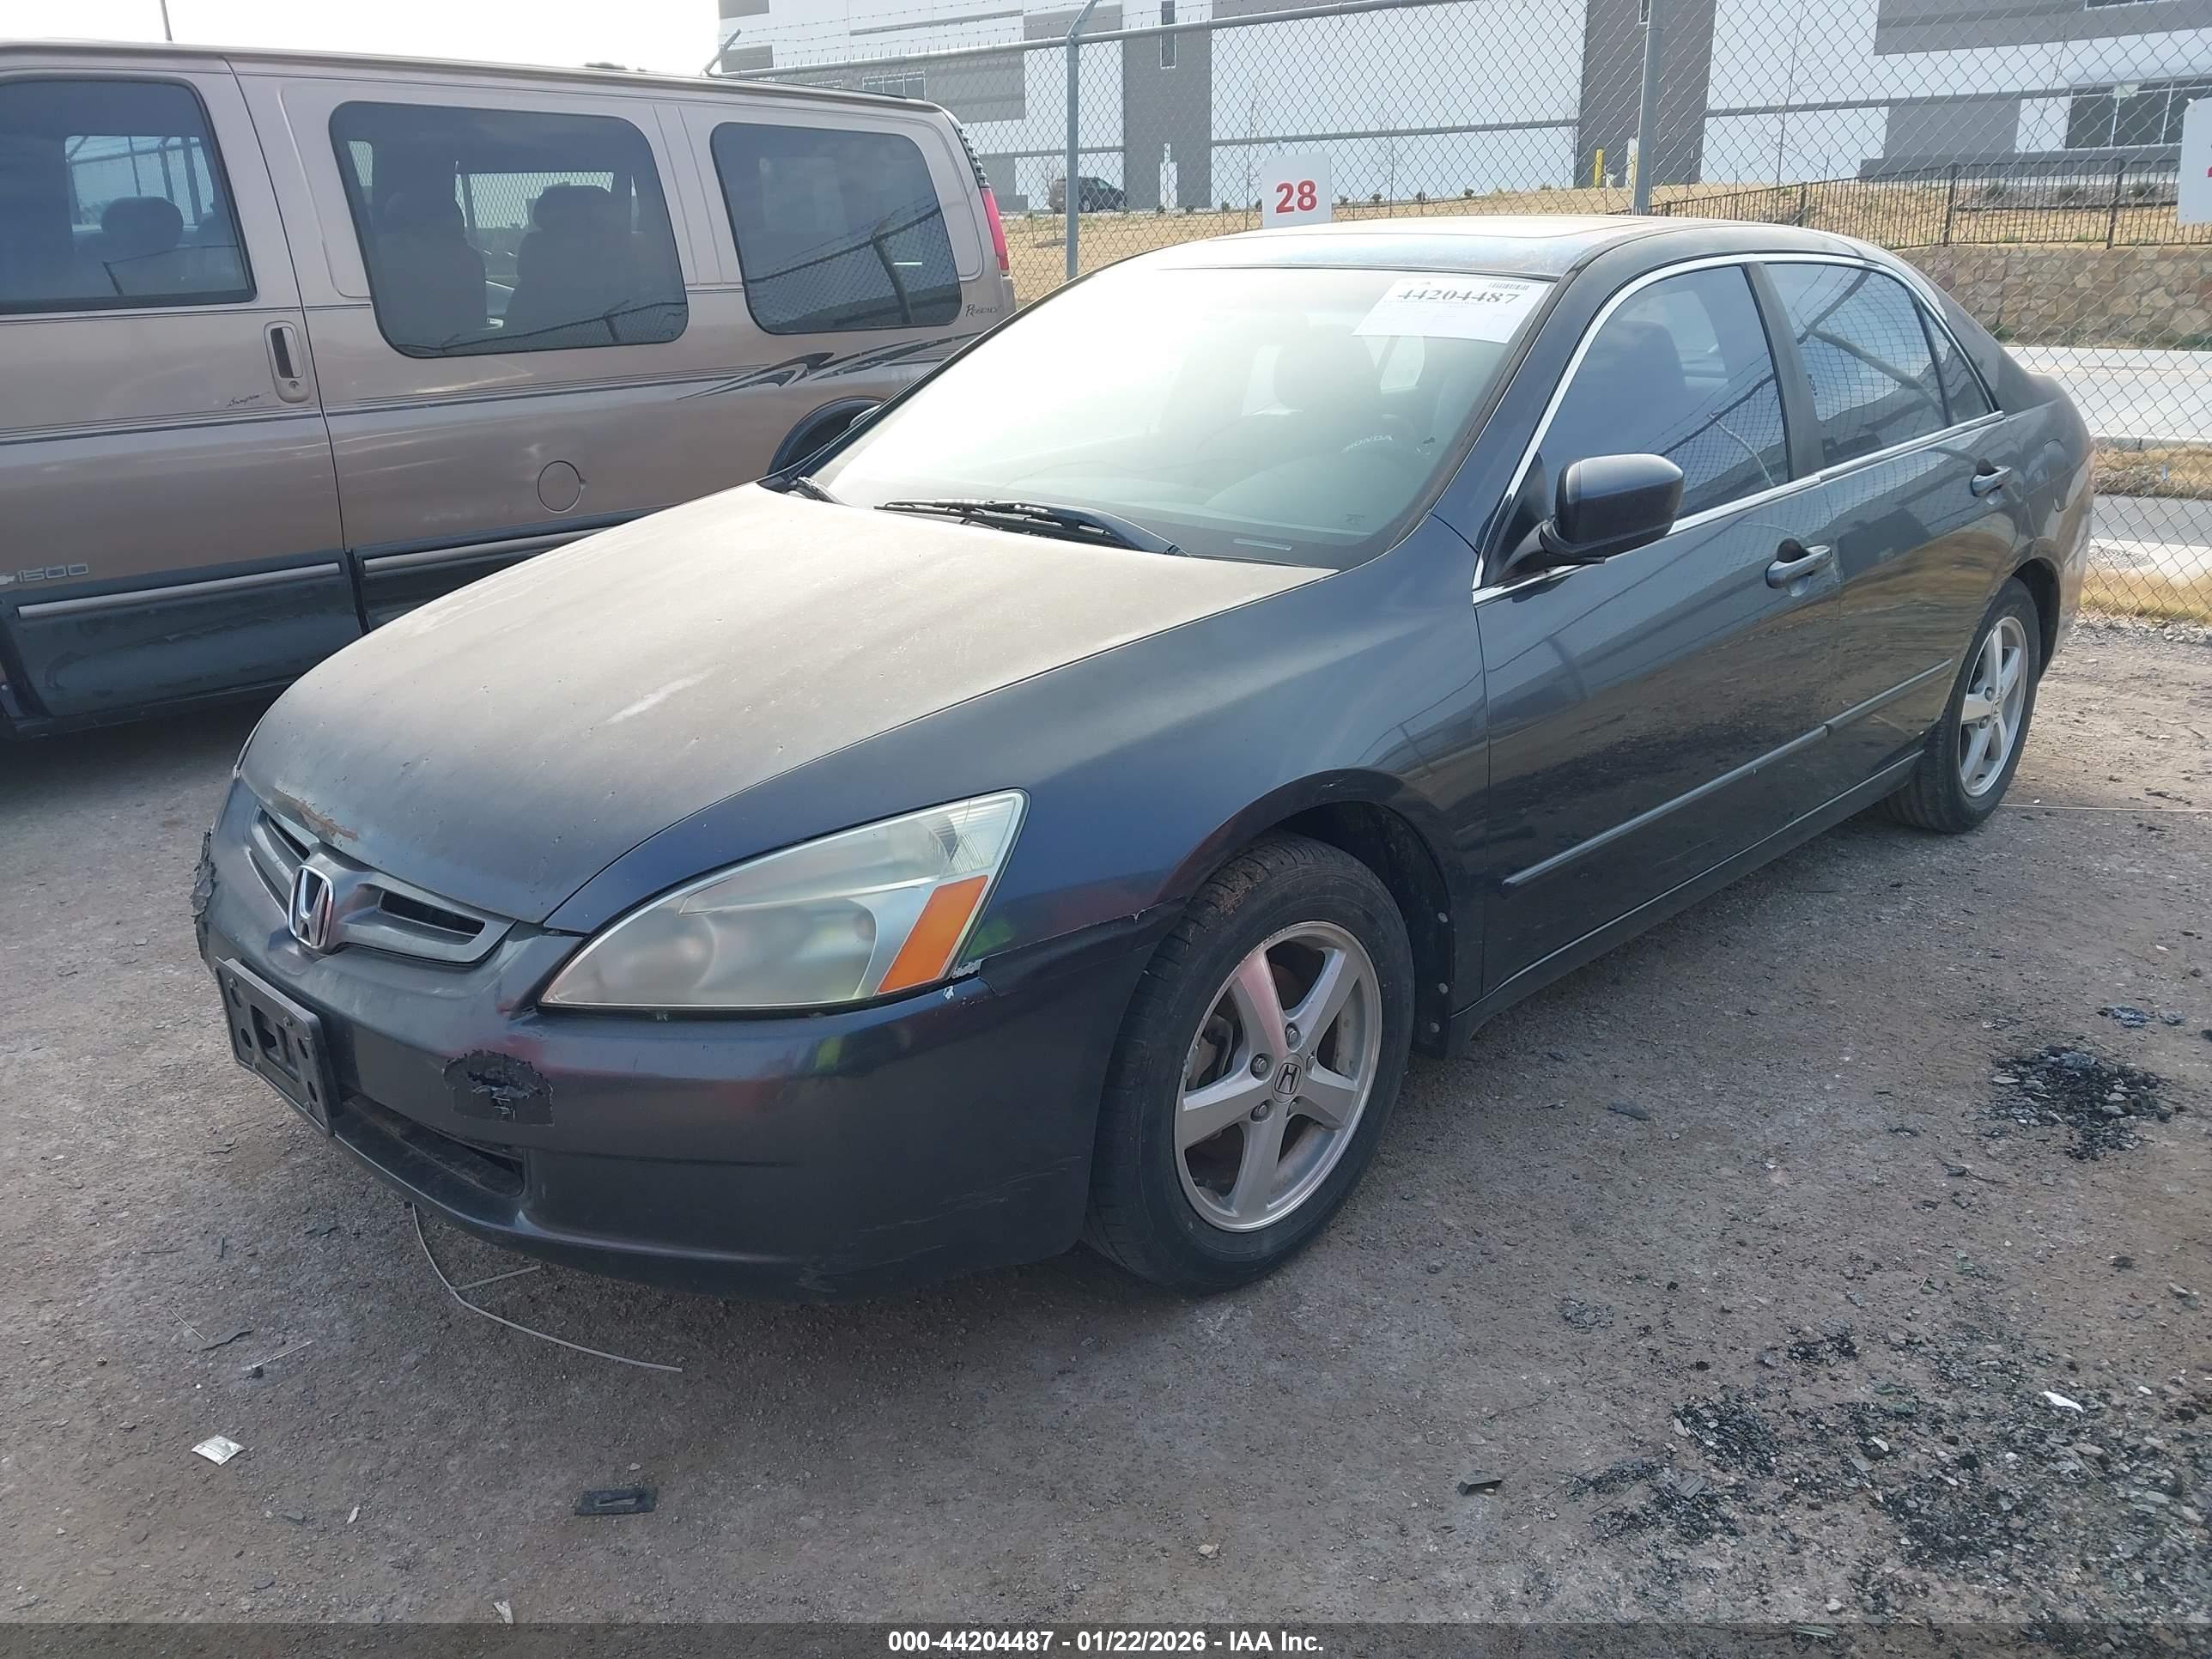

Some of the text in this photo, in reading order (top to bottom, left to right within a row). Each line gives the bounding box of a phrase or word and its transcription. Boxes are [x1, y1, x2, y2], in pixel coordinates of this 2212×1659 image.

[1275, 179, 1317, 214] 28
[1398, 288, 1522, 305] 44204487
[17, 563, 89, 583] 1500
